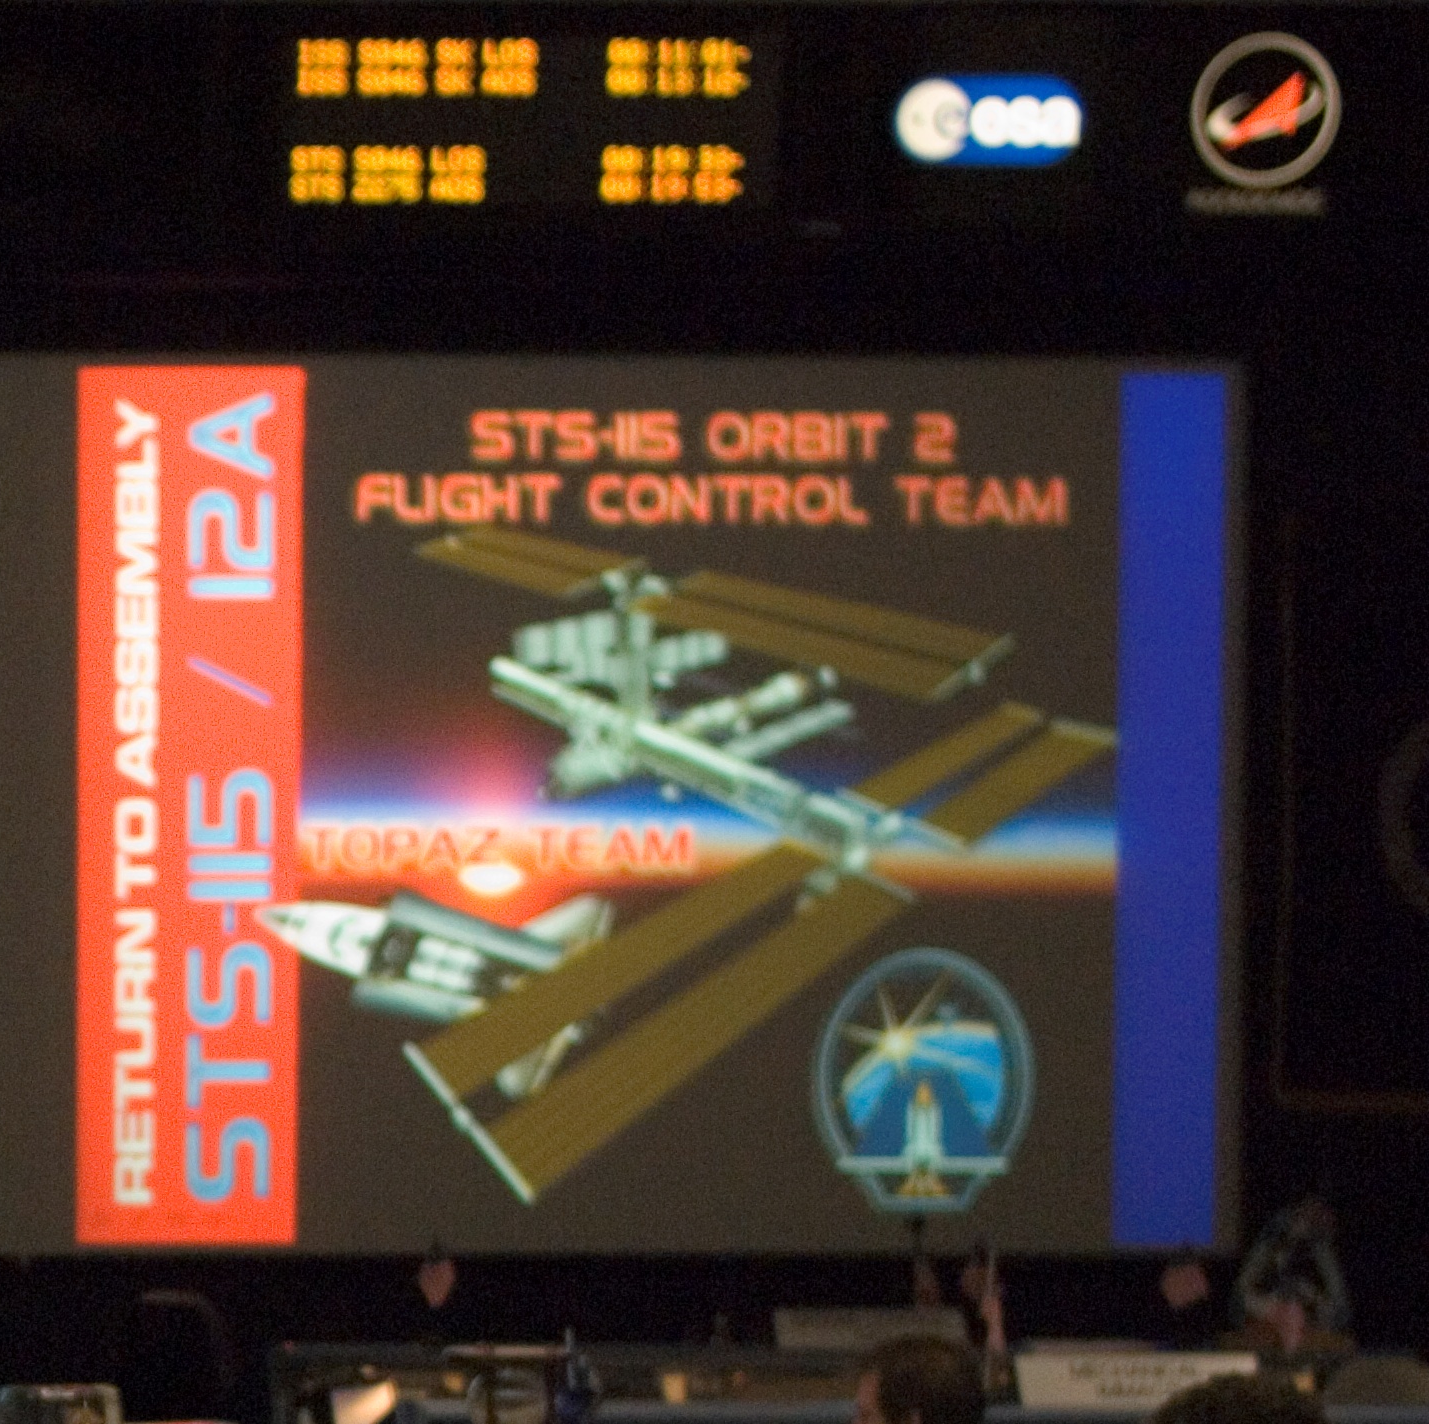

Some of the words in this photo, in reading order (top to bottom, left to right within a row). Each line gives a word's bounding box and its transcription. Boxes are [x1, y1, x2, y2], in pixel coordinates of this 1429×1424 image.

[970, 93, 1083, 149] esa
[469, 411, 682, 463] STS-115
[707, 412, 887, 463] ORBIT
[913, 413, 958, 463] 2
[185, 393, 277, 602] 12A
[354, 474, 560, 524] FLIGHT
[588, 475, 870, 526] CONTROL
[895, 475, 1070, 528] TEAM
[113, 400, 159, 787] ASSEMBLY
[113, 798, 159, 899] TO
[311, 827, 503, 871] TOPAZ
[539, 827, 695, 870] TEAM
[185, 766, 276, 1203] STS-115
[113, 912, 159, 1206] RETURN
